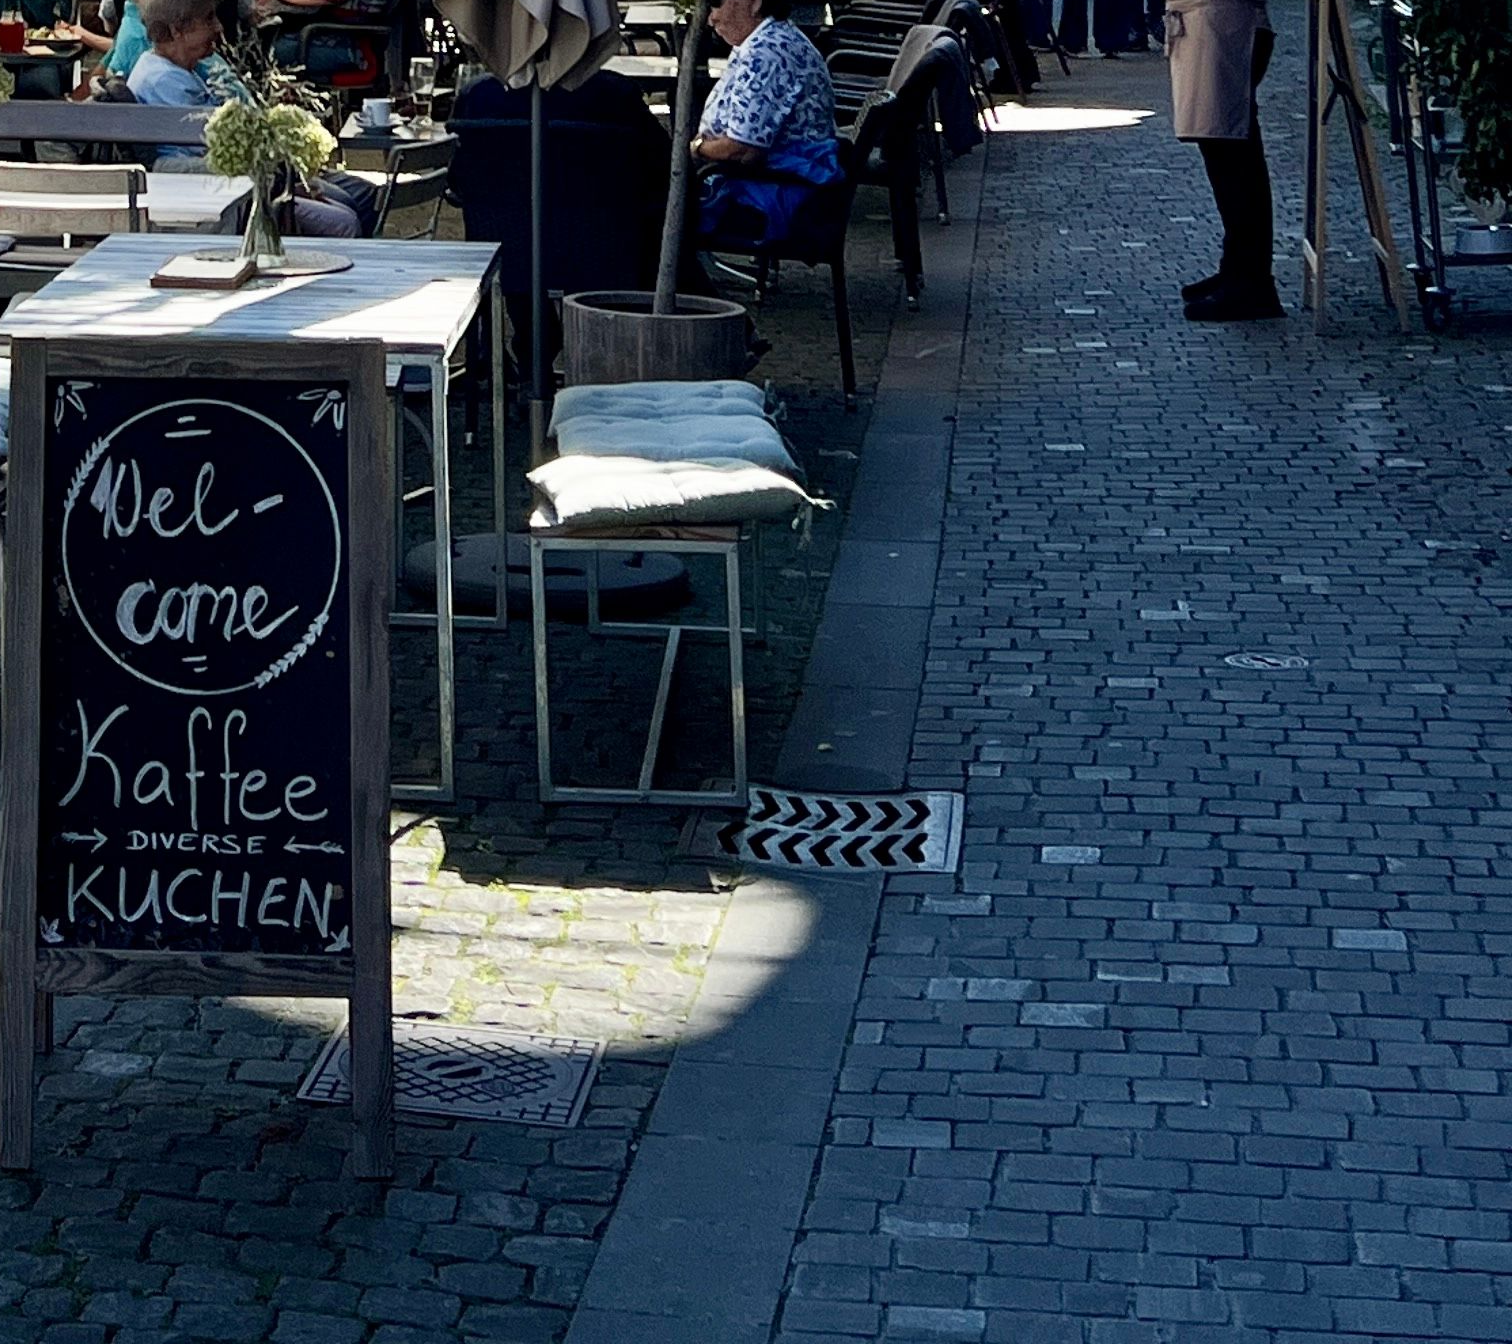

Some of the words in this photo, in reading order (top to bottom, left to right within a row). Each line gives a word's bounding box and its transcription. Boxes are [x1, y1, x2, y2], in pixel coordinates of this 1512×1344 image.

[58, 698, 329, 831] Kaffee
[125, 830, 267, 854] DIVERSE
[67, 862, 334, 939] KUCHEN
